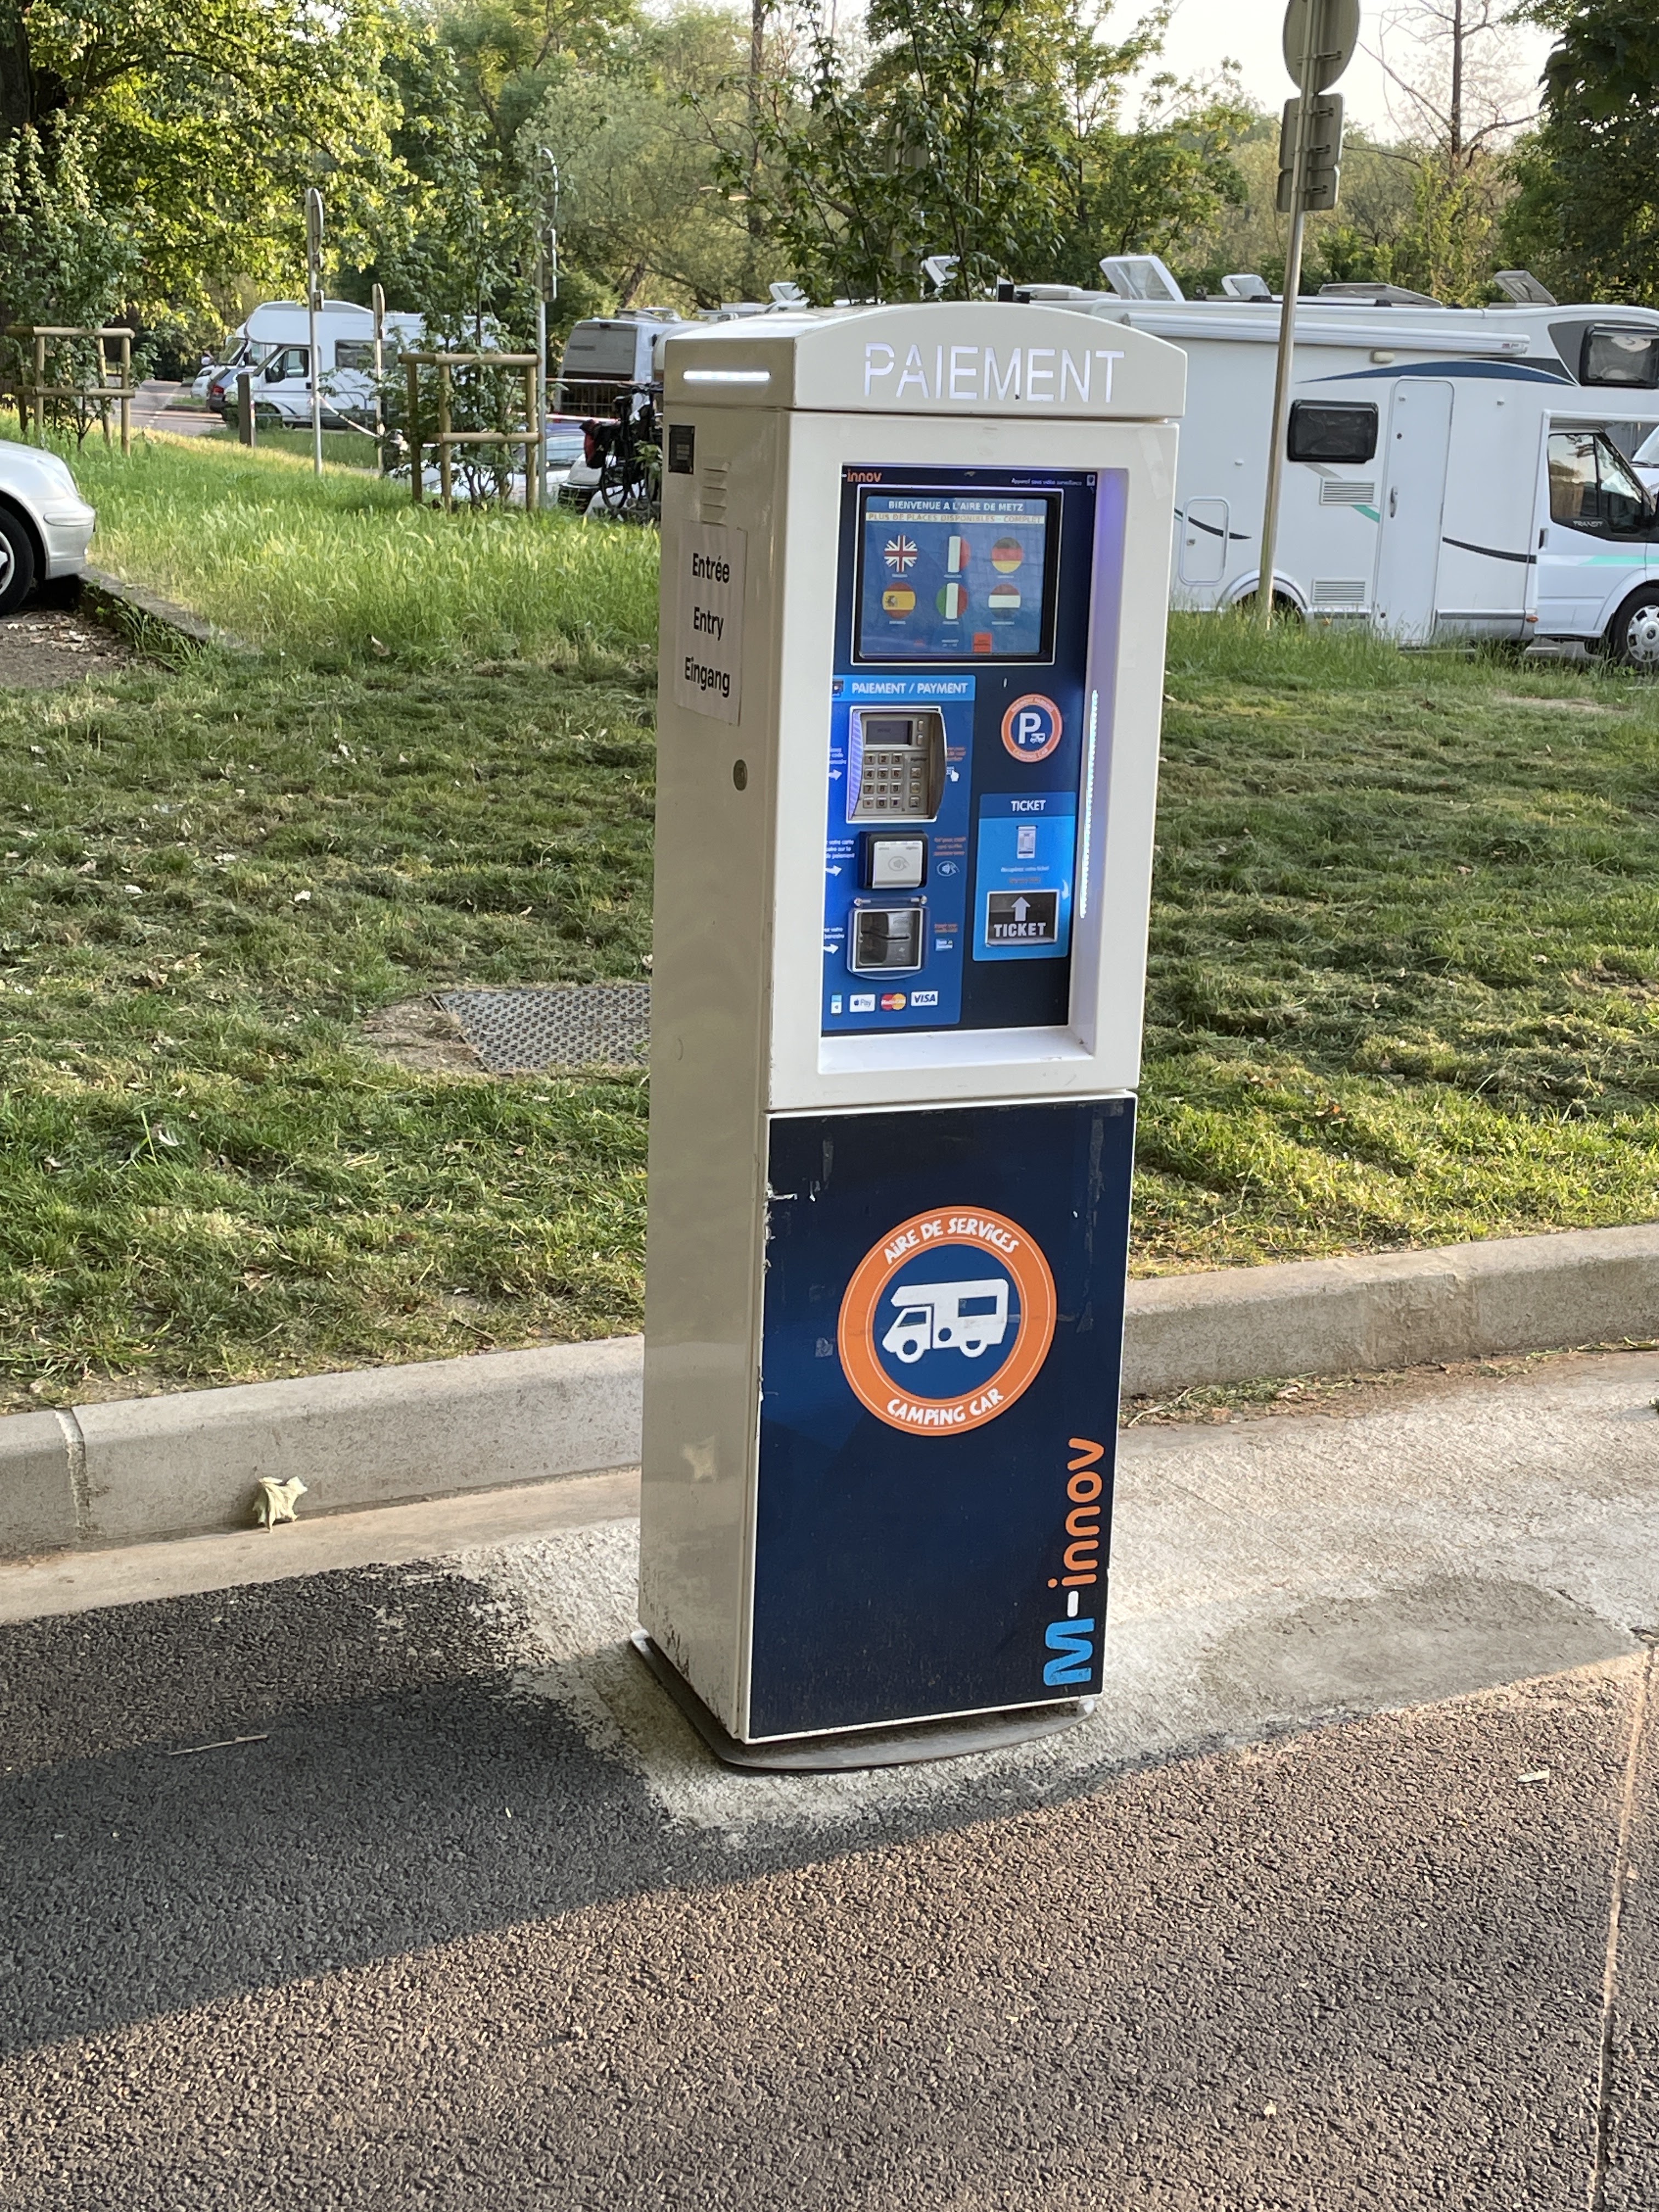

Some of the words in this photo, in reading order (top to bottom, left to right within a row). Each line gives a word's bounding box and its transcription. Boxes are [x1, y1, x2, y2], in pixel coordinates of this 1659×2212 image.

[864, 342, 1125, 403] PAIEMENT
[889, 500, 940, 510] BIENVENUE
[943, 502, 950, 510] A
[952, 501, 981, 511] L'AIRE
[984, 503, 996, 511] DE
[998, 503, 1024, 512] METZ
[692, 552, 730, 584] Entrée
[693, 607, 724, 641] Entry
[684, 657, 730, 698] Eingang
[851, 682, 906, 694] PAIEMENT
[917, 682, 968, 694] PAYMENT
[1018, 712, 1041, 744] P
[1011, 800, 1047, 811] TICKET
[994, 922, 1047, 937] TICKET
[914, 994, 936, 1003] VISA
[920, 1219, 944, 1242] DE
[969, 1388, 1005, 1417] CAR
